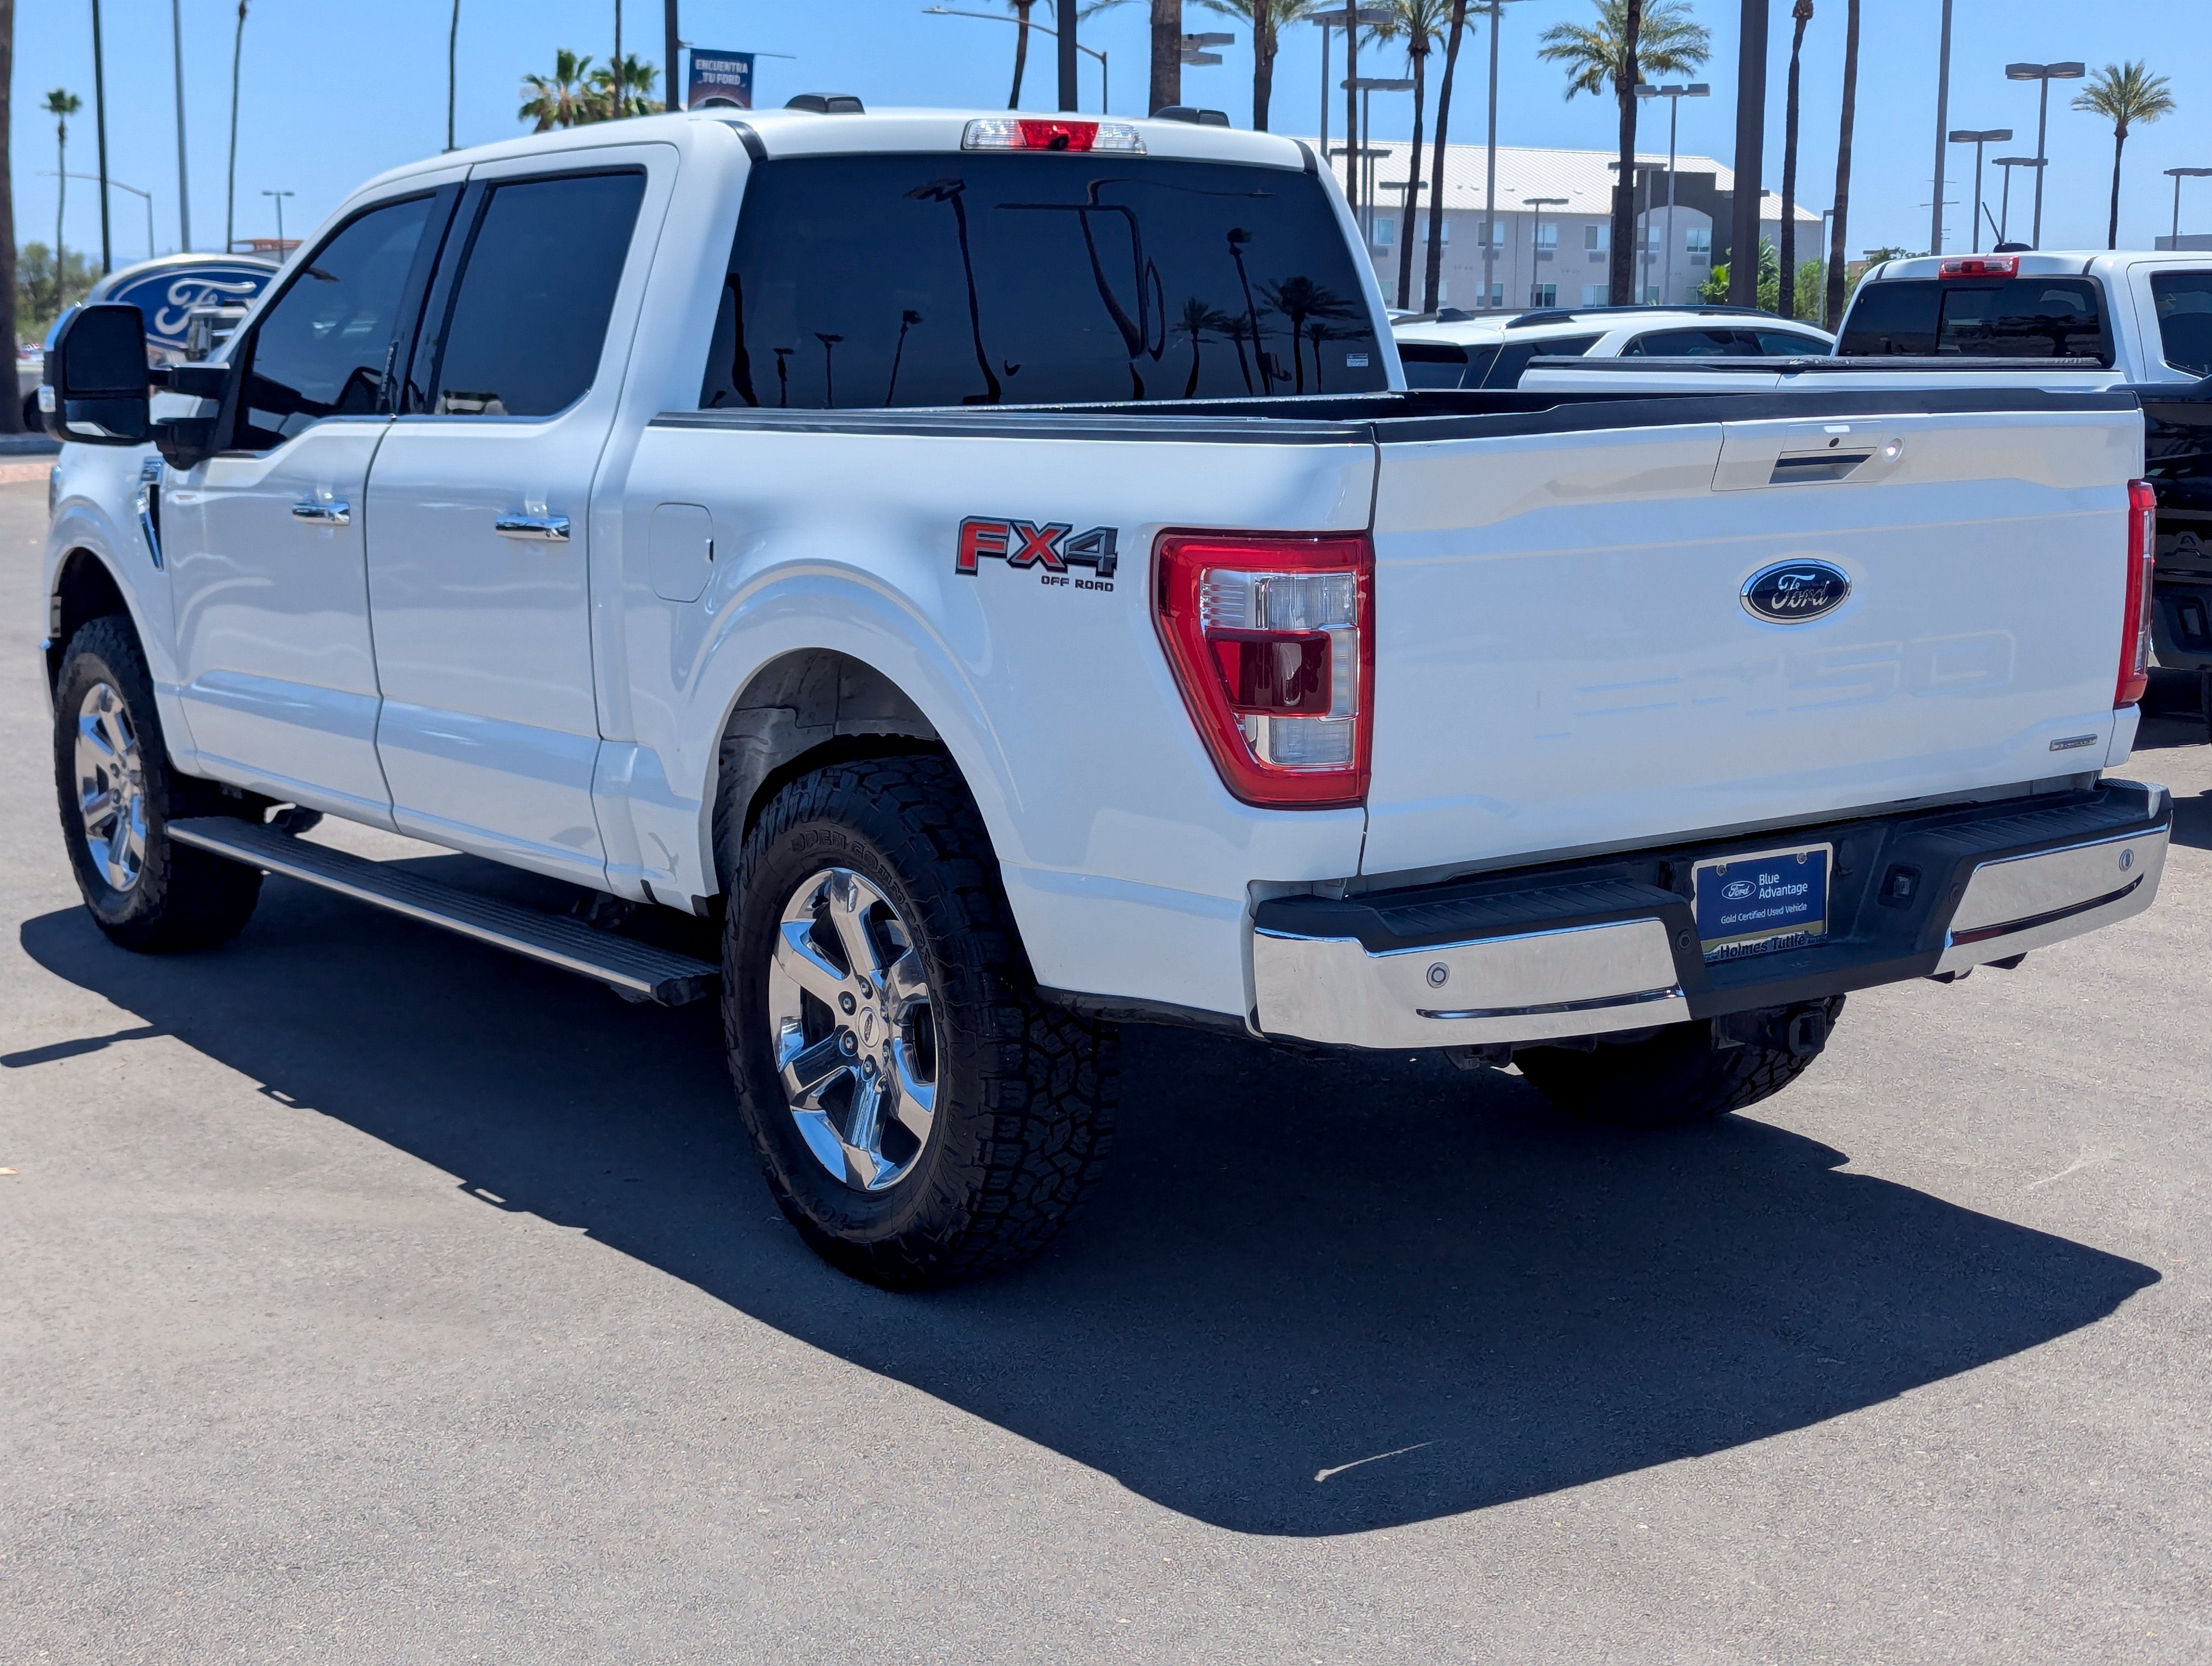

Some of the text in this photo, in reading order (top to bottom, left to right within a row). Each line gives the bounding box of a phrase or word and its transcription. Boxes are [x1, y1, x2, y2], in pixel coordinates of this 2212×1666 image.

[696, 59, 748, 74] ENCUENTRA
[702, 72, 741, 85] TU FORD
[955, 515, 1119, 579] FX4
[1041, 575, 1114, 592] OFF ROAD
[1771, 573, 1830, 610] Ford
[1759, 873, 1780, 886] Blue
[1727, 883, 1750, 898] Ford
[1758, 882, 1808, 900] Advantage
[1720, 902, 1807, 924] Gold Certified Used Vehicle
[1720, 941, 1768, 959] Holmes
